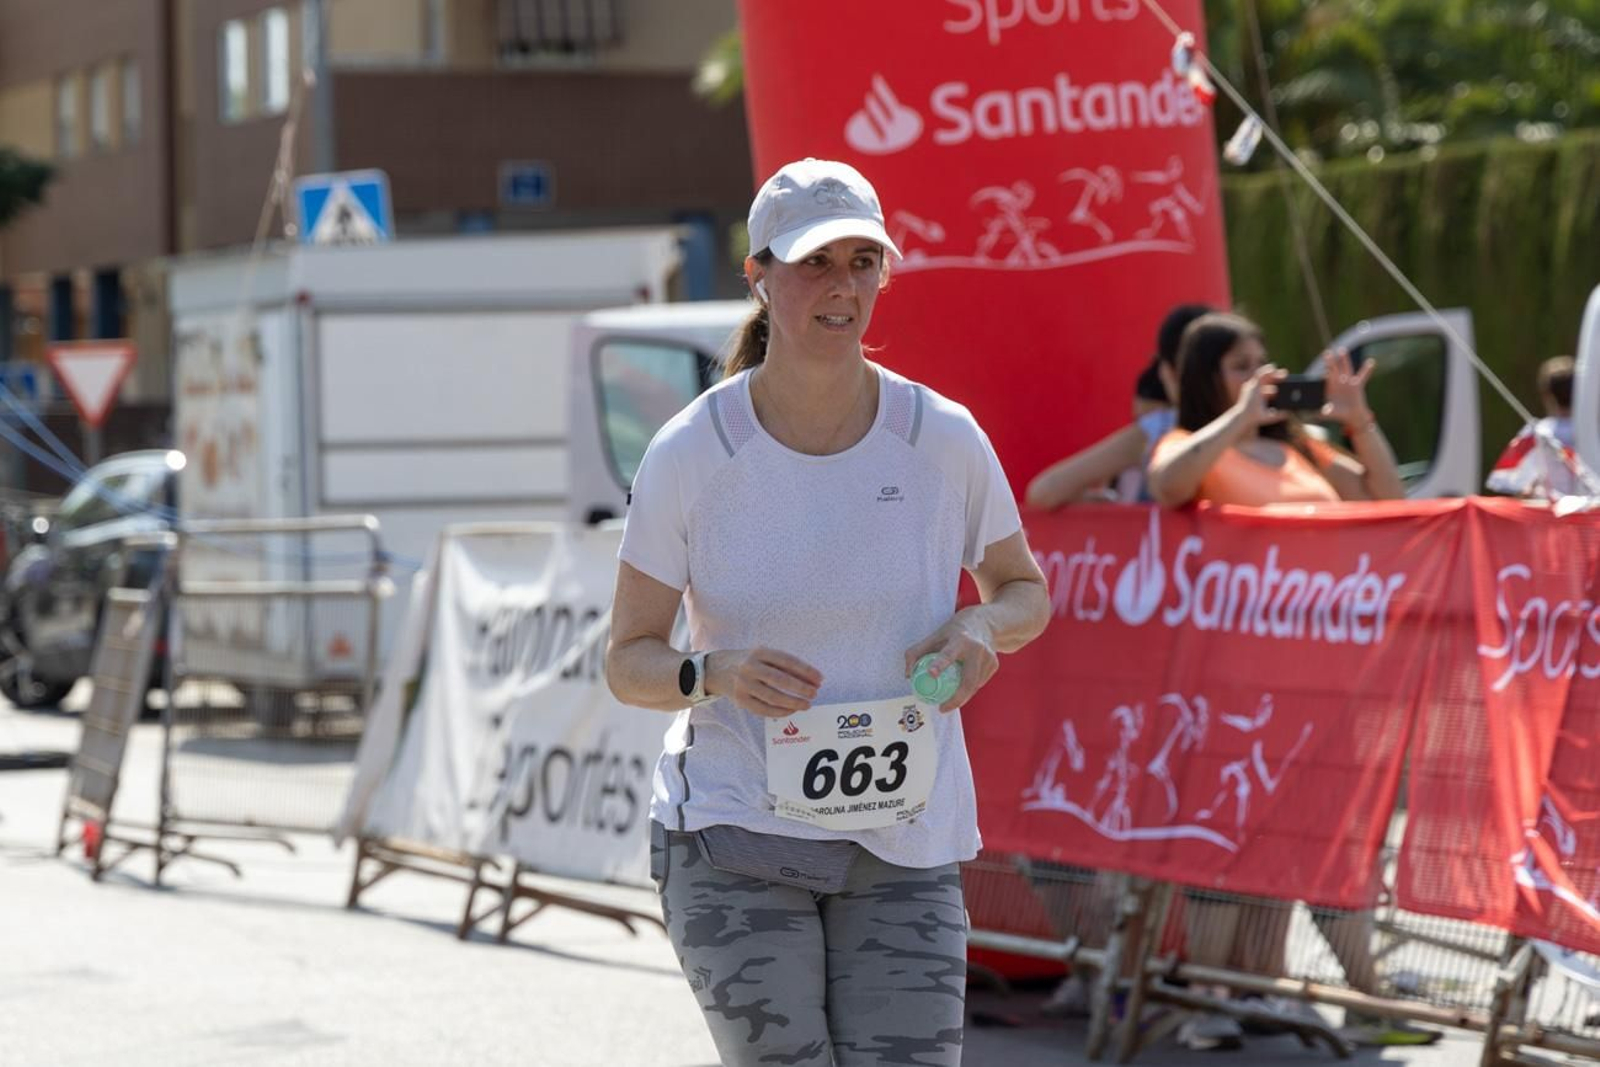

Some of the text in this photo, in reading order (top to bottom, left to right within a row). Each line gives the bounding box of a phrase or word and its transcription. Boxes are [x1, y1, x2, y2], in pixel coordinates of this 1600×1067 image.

[929, 71, 1206, 145] Santande
[1162, 535, 1406, 645] Santander
[802, 741, 909, 800] 663
[811, 805, 845, 816] AROLINA
